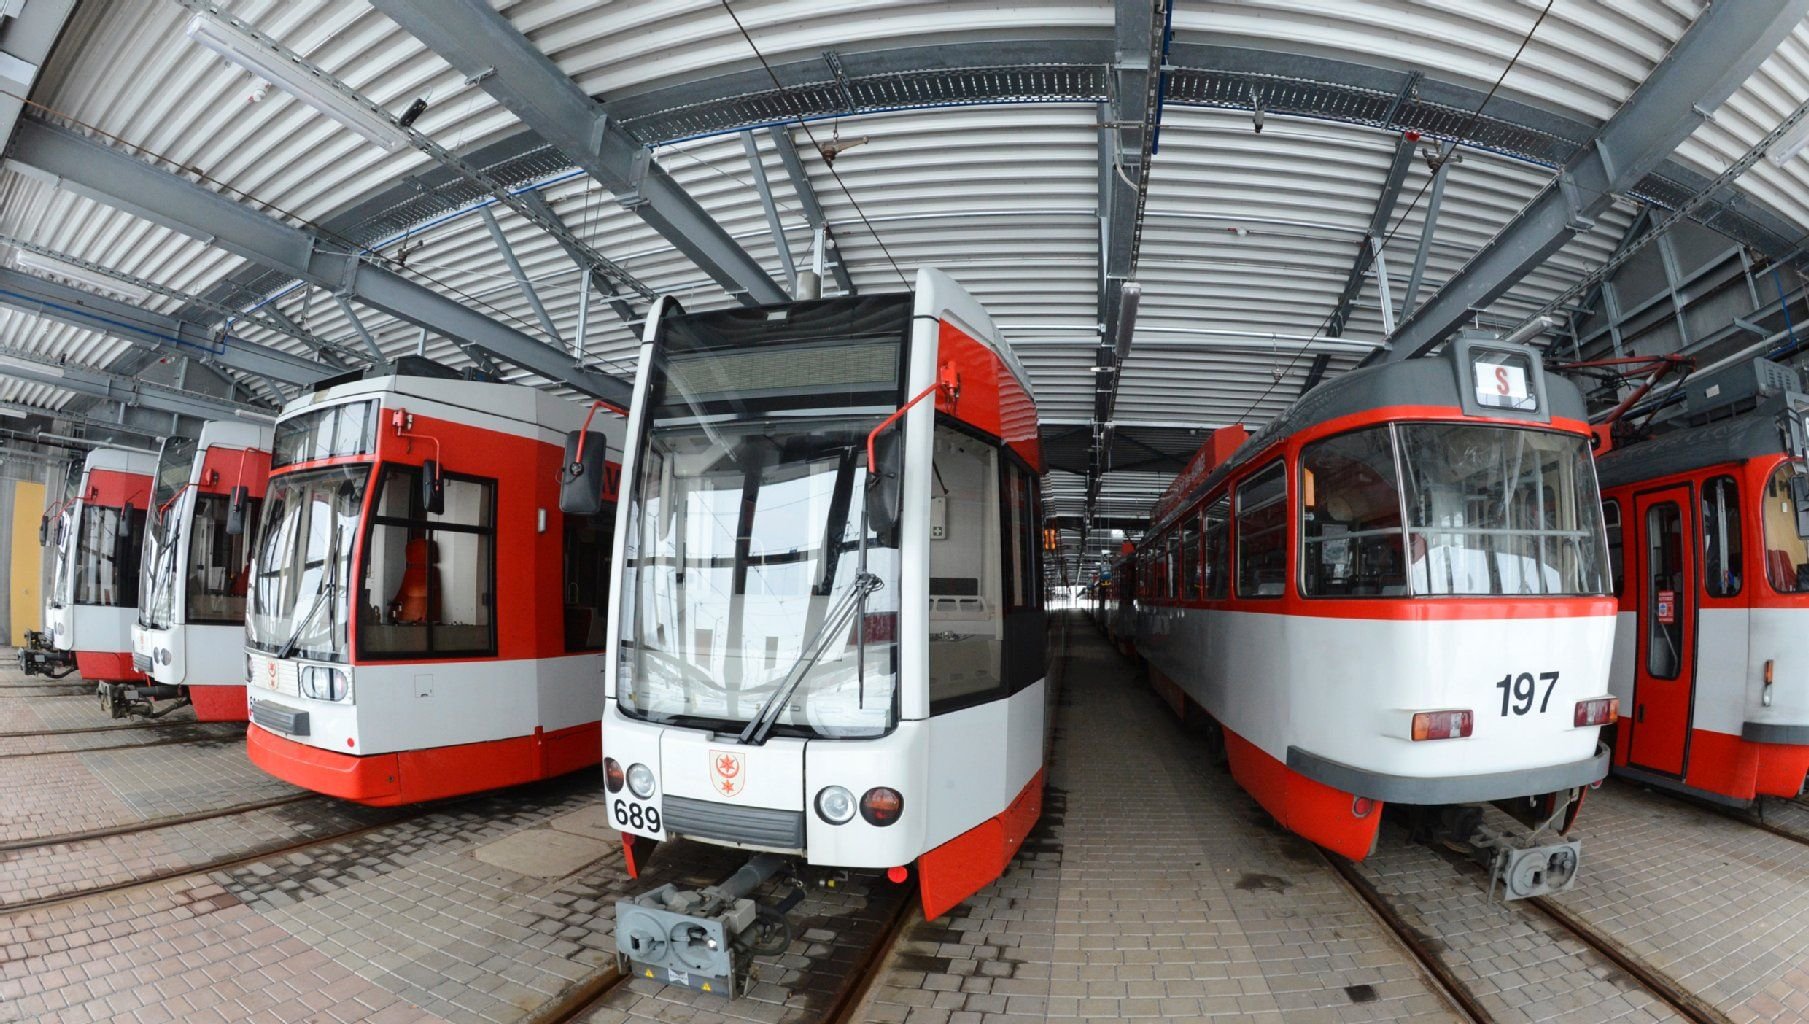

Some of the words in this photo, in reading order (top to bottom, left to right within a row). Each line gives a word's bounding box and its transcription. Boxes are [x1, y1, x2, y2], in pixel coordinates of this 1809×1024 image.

[1495, 367, 1510, 396] S
[1496, 671, 1560, 717] 197
[614, 798, 661, 833] 689
